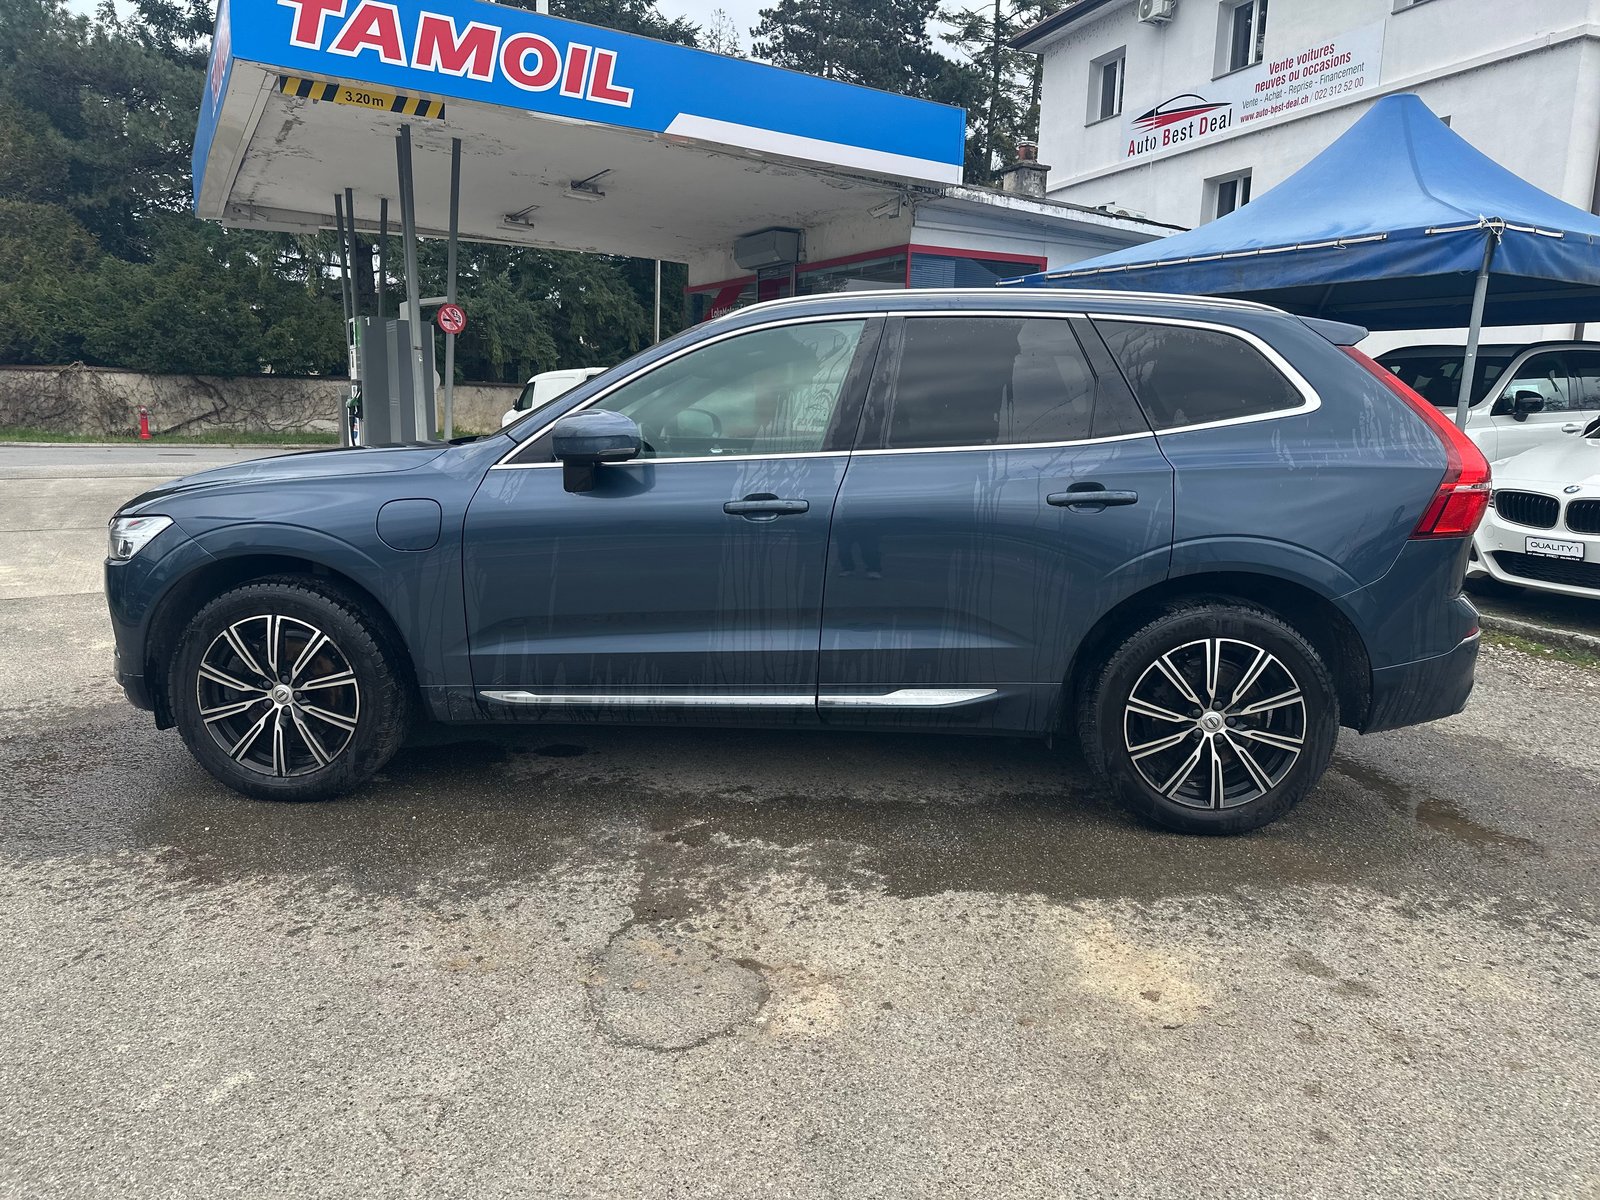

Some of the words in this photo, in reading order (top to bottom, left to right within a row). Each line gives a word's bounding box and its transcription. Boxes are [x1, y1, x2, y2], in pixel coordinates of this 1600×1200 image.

[277, 0, 634, 108] TAMOIL
[1254, 75, 1286, 93] neuves
[1288, 70, 1300, 82] ou
[1302, 51, 1352, 78] occasions
[1268, 57, 1294, 75] Vente
[1296, 43, 1335, 66] voitures
[345, 90, 370, 105] 3.20
[372, 97, 384, 107] m
[1240, 95, 1309, 123] www.auto-best-deal.ch
[1314, 86, 1328, 101] 022
[1328, 83, 1342, 97] 312
[1343, 80, 1353, 92] 52
[1354, 76, 1365, 88] 00
[1242, 98, 1259, 109] Vente
[1263, 91, 1283, 103] Achat
[1288, 80, 1313, 97] Reprise
[1319, 62, 1365, 84] Financement
[1127, 135, 1157, 157] Auto
[1162, 121, 1194, 147] Best
[1199, 107, 1233, 136] Deal
[1530, 541, 1573, 552] QUALITY
